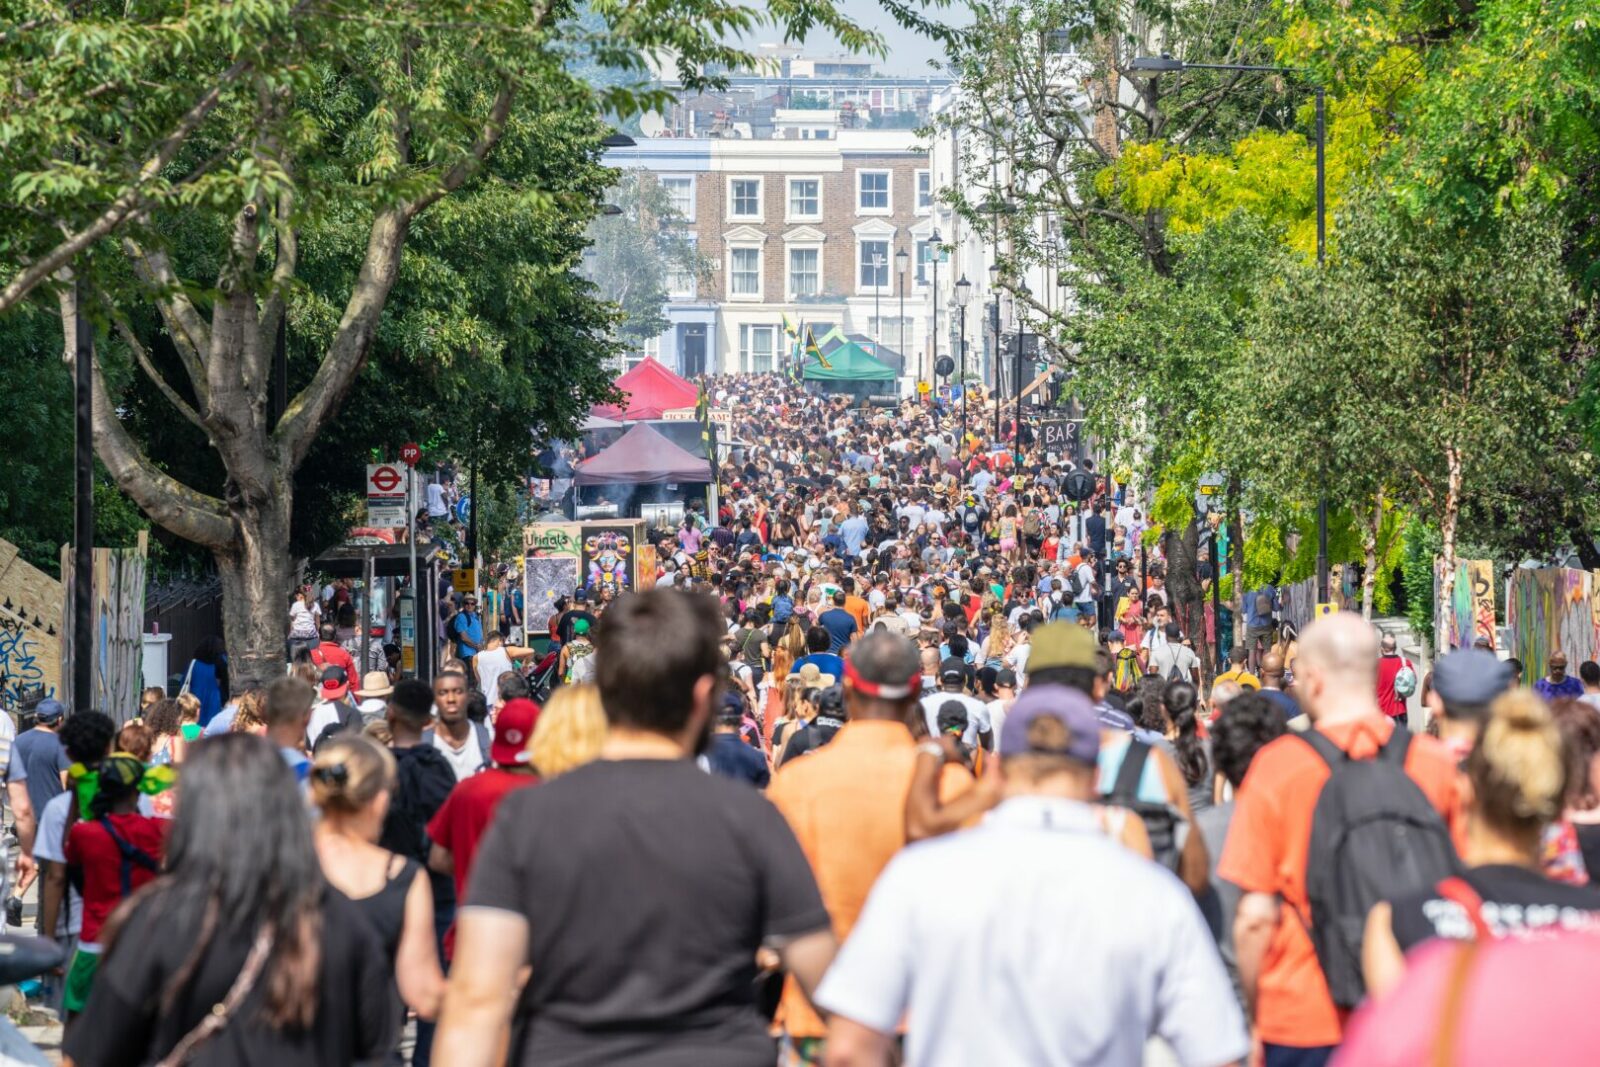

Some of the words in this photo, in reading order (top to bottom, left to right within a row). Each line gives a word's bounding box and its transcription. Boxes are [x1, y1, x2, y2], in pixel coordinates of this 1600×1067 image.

[1046, 423, 1076, 443] BAR
[404, 448, 417, 458] PP
[525, 533, 568, 546] Urinals
